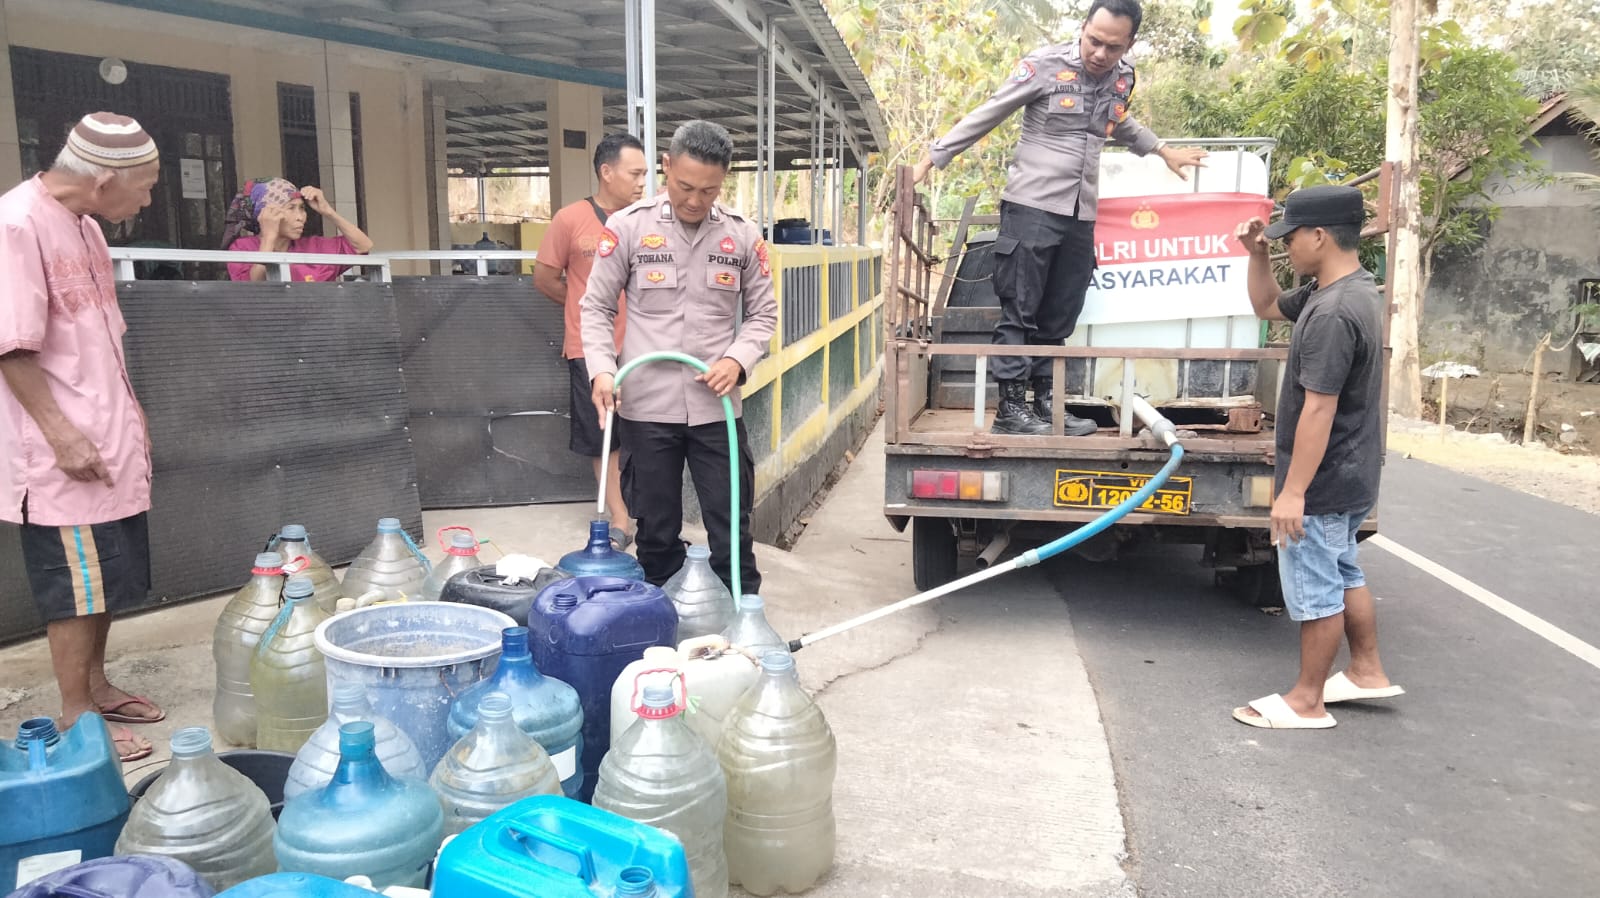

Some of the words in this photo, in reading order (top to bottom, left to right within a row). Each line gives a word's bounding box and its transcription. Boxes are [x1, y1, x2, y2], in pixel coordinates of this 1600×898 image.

[1094, 241, 1136, 261] LRI
[1145, 235, 1230, 258] UNTUK
[637, 254, 674, 264] YOHANA
[708, 254, 743, 267] POLRI
[1088, 265, 1230, 290] ASYARAKAT
[1098, 490, 1184, 511] 1202-56
